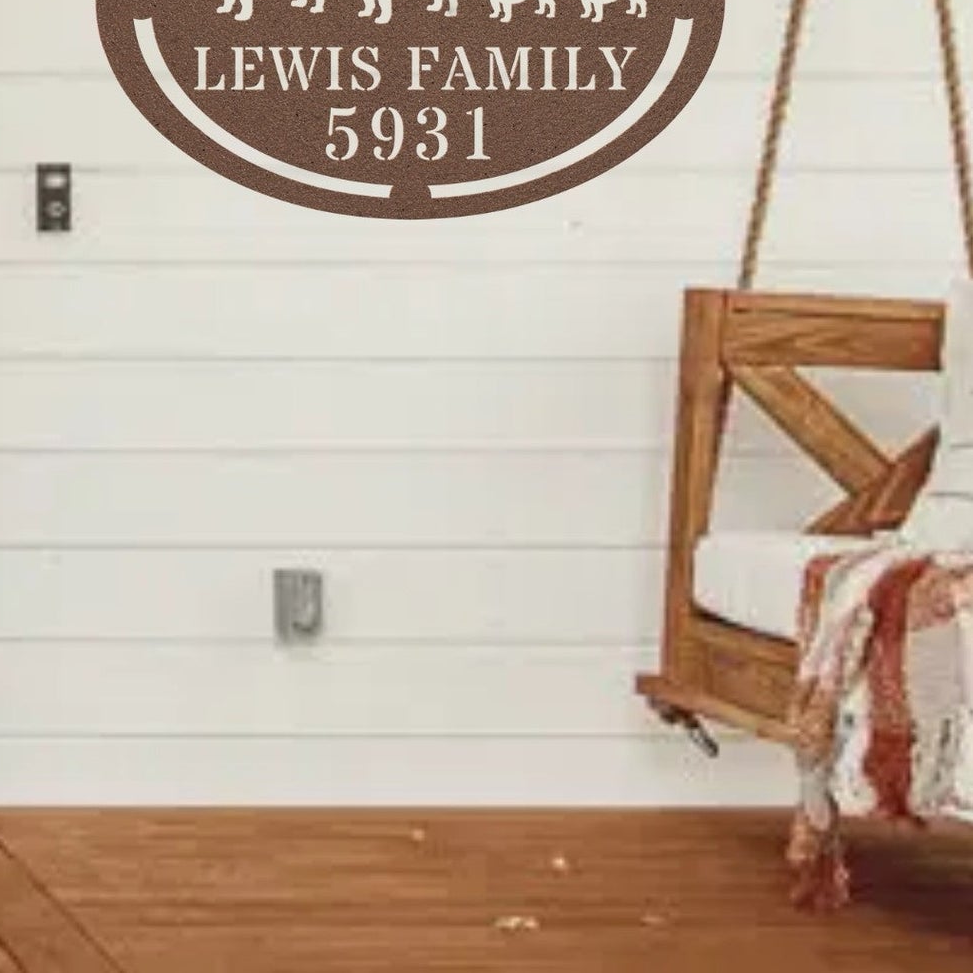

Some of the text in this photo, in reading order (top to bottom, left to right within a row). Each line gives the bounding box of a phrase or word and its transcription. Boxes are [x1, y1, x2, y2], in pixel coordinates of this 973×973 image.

[193, 46, 638, 92] LEWIS FAMILY
[325, 106, 492, 161] 5931
